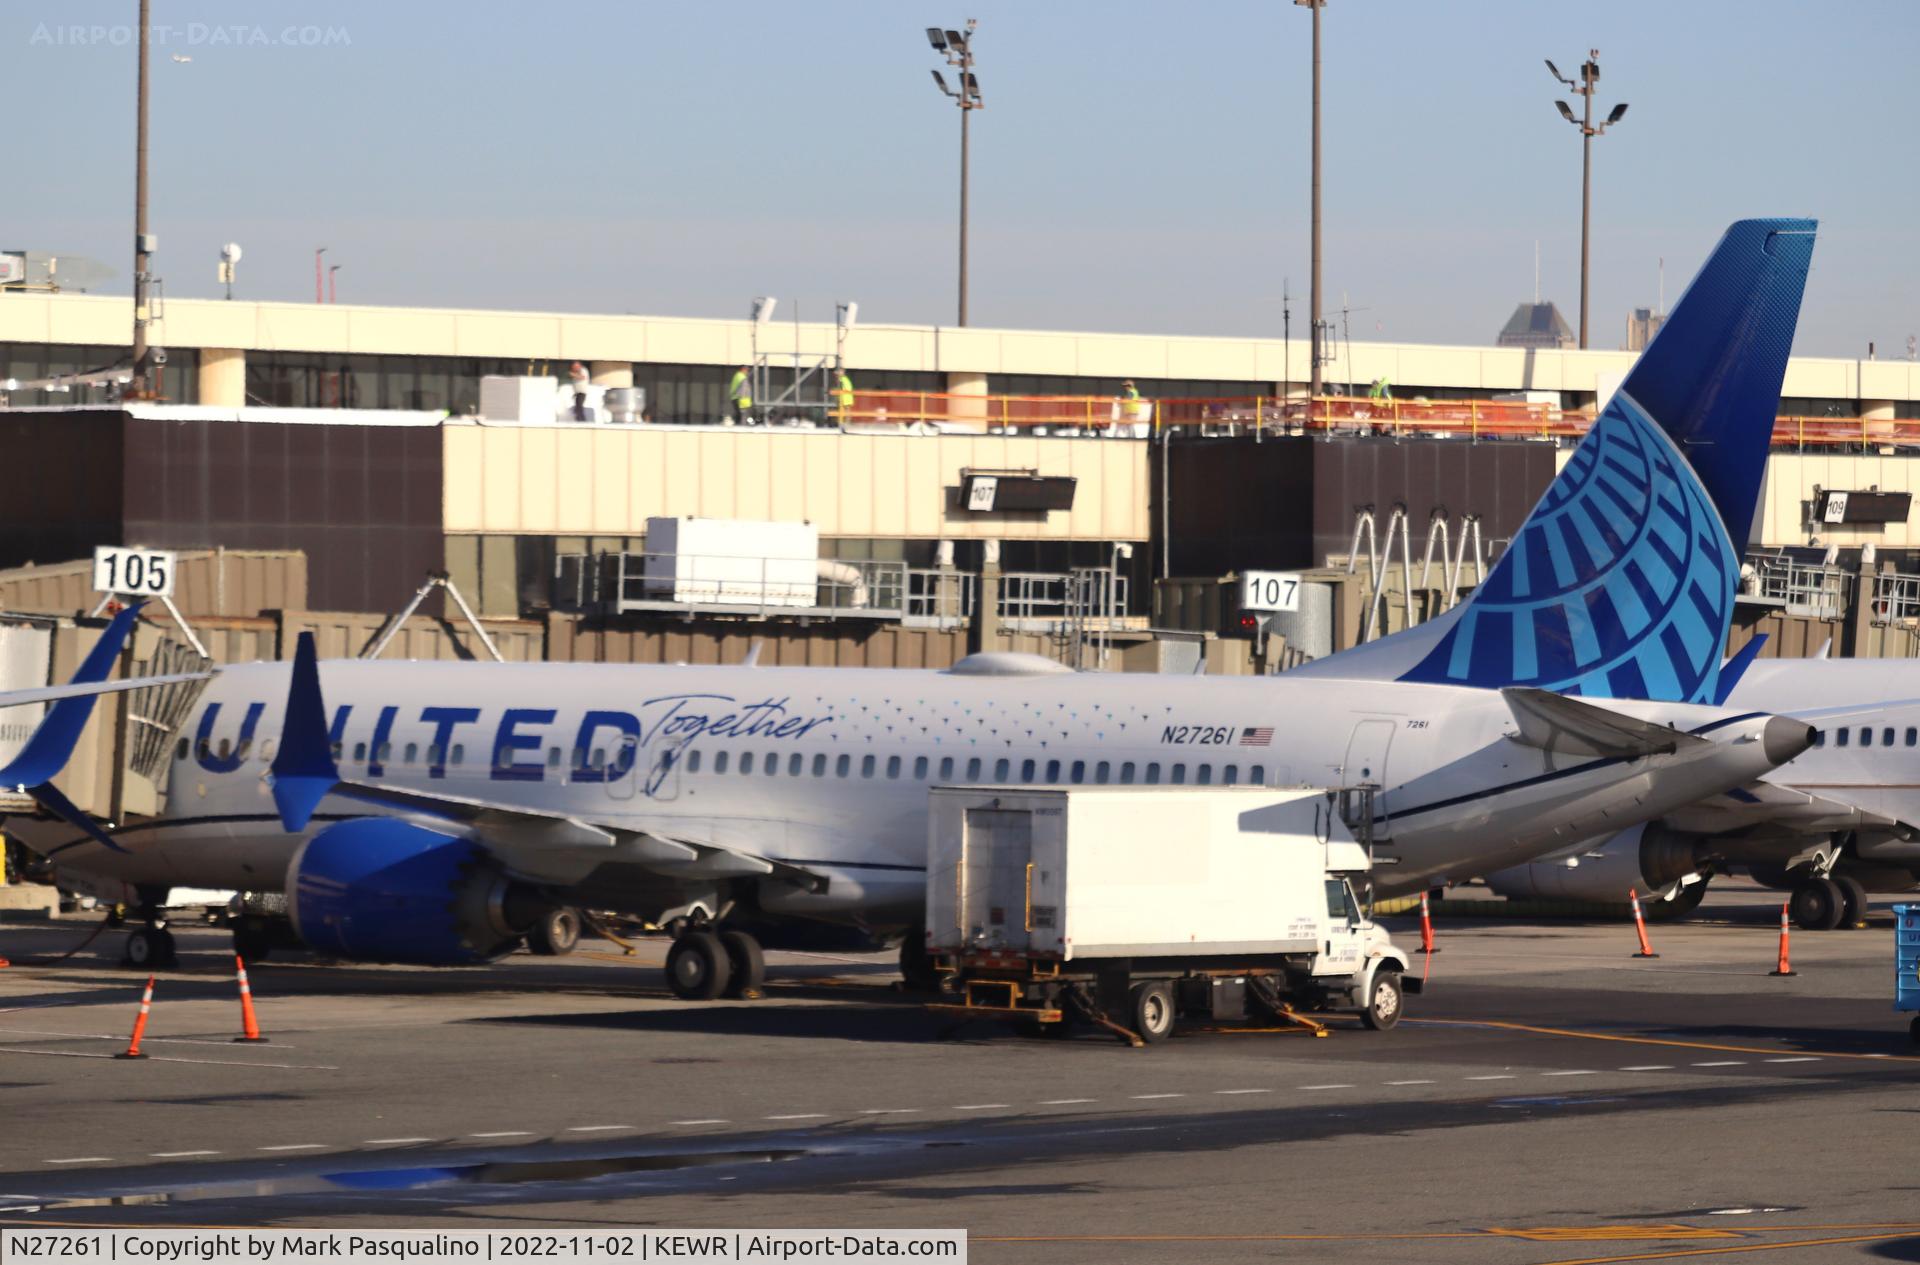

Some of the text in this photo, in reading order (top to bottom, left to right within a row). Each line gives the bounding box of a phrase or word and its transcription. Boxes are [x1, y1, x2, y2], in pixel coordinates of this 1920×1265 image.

[973, 486, 994, 502] 107
[1828, 501, 1844, 515] 109
[104, 553, 166, 591] 105
[1251, 577, 1298, 607] 107
[1406, 720, 1429, 729] 7261
[1161, 726, 1234, 745] N27261
[641, 694, 835, 797] Together
